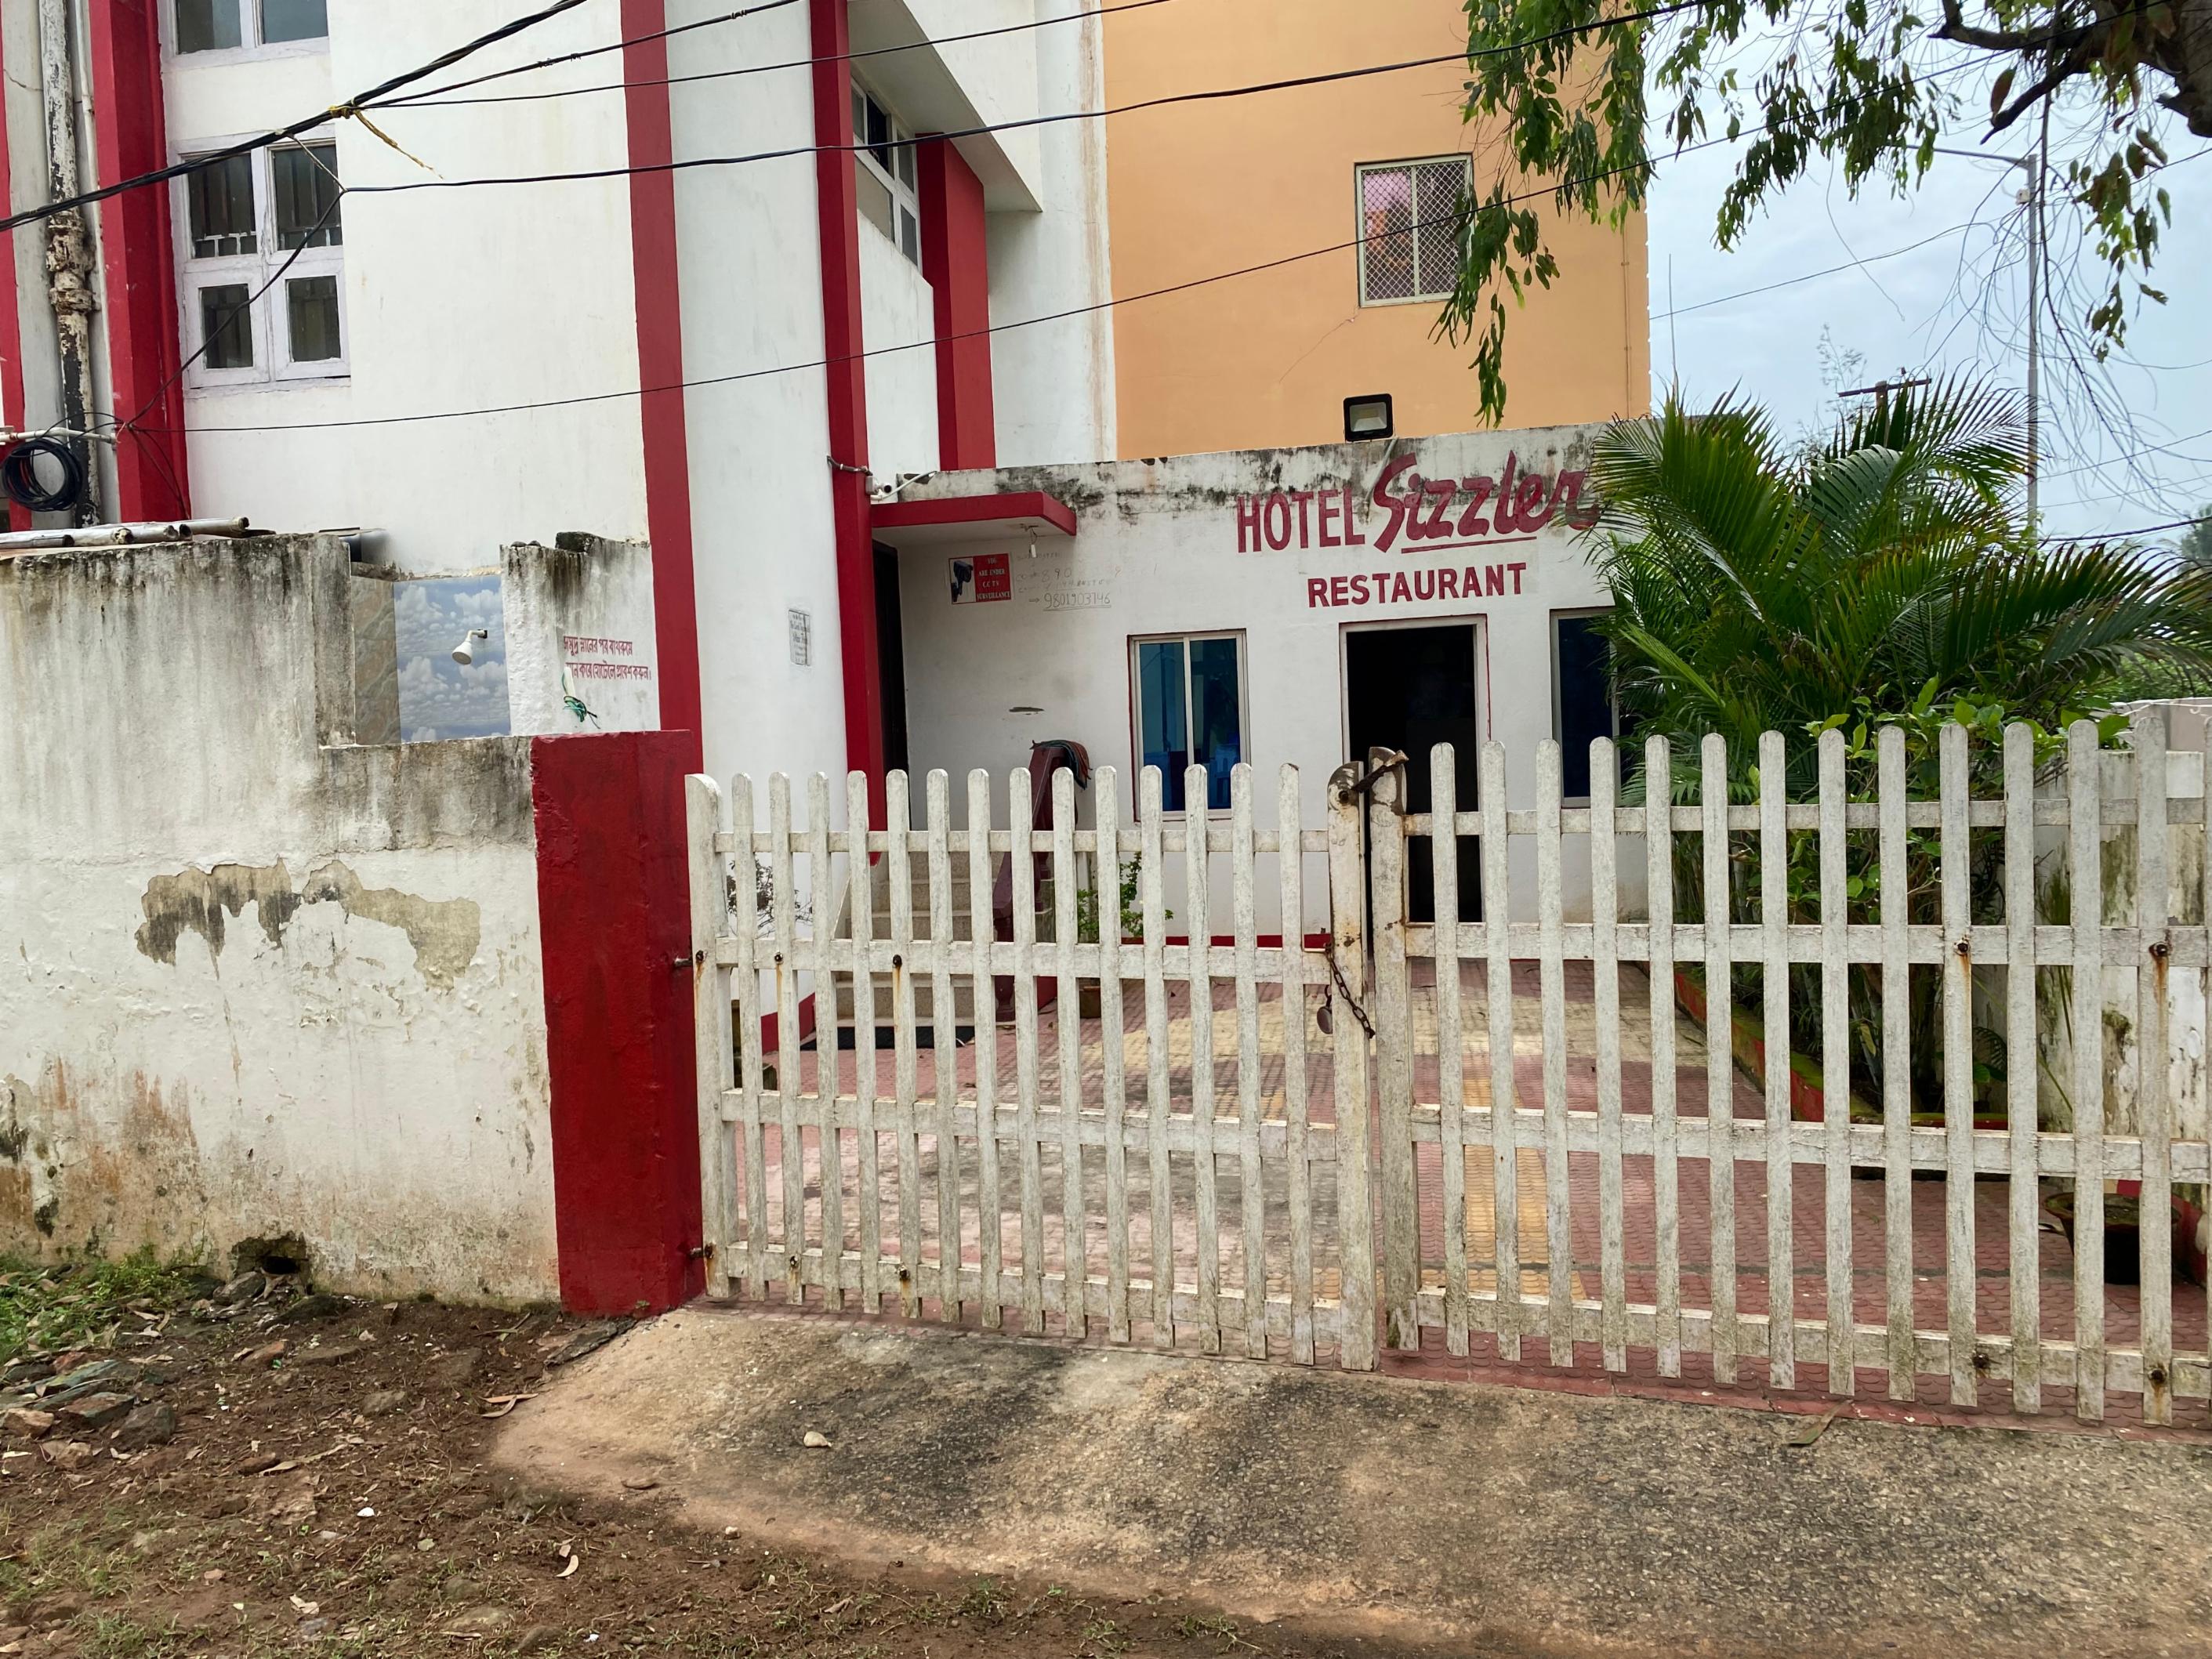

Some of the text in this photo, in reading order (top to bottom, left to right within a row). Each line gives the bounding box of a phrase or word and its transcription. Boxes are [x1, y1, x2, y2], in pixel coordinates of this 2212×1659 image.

[1237, 487, 1365, 553] HOTEL
[977, 591, 1010, 600] SURVEILLANCE
[1307, 562, 1526, 608] RESTAURANT
